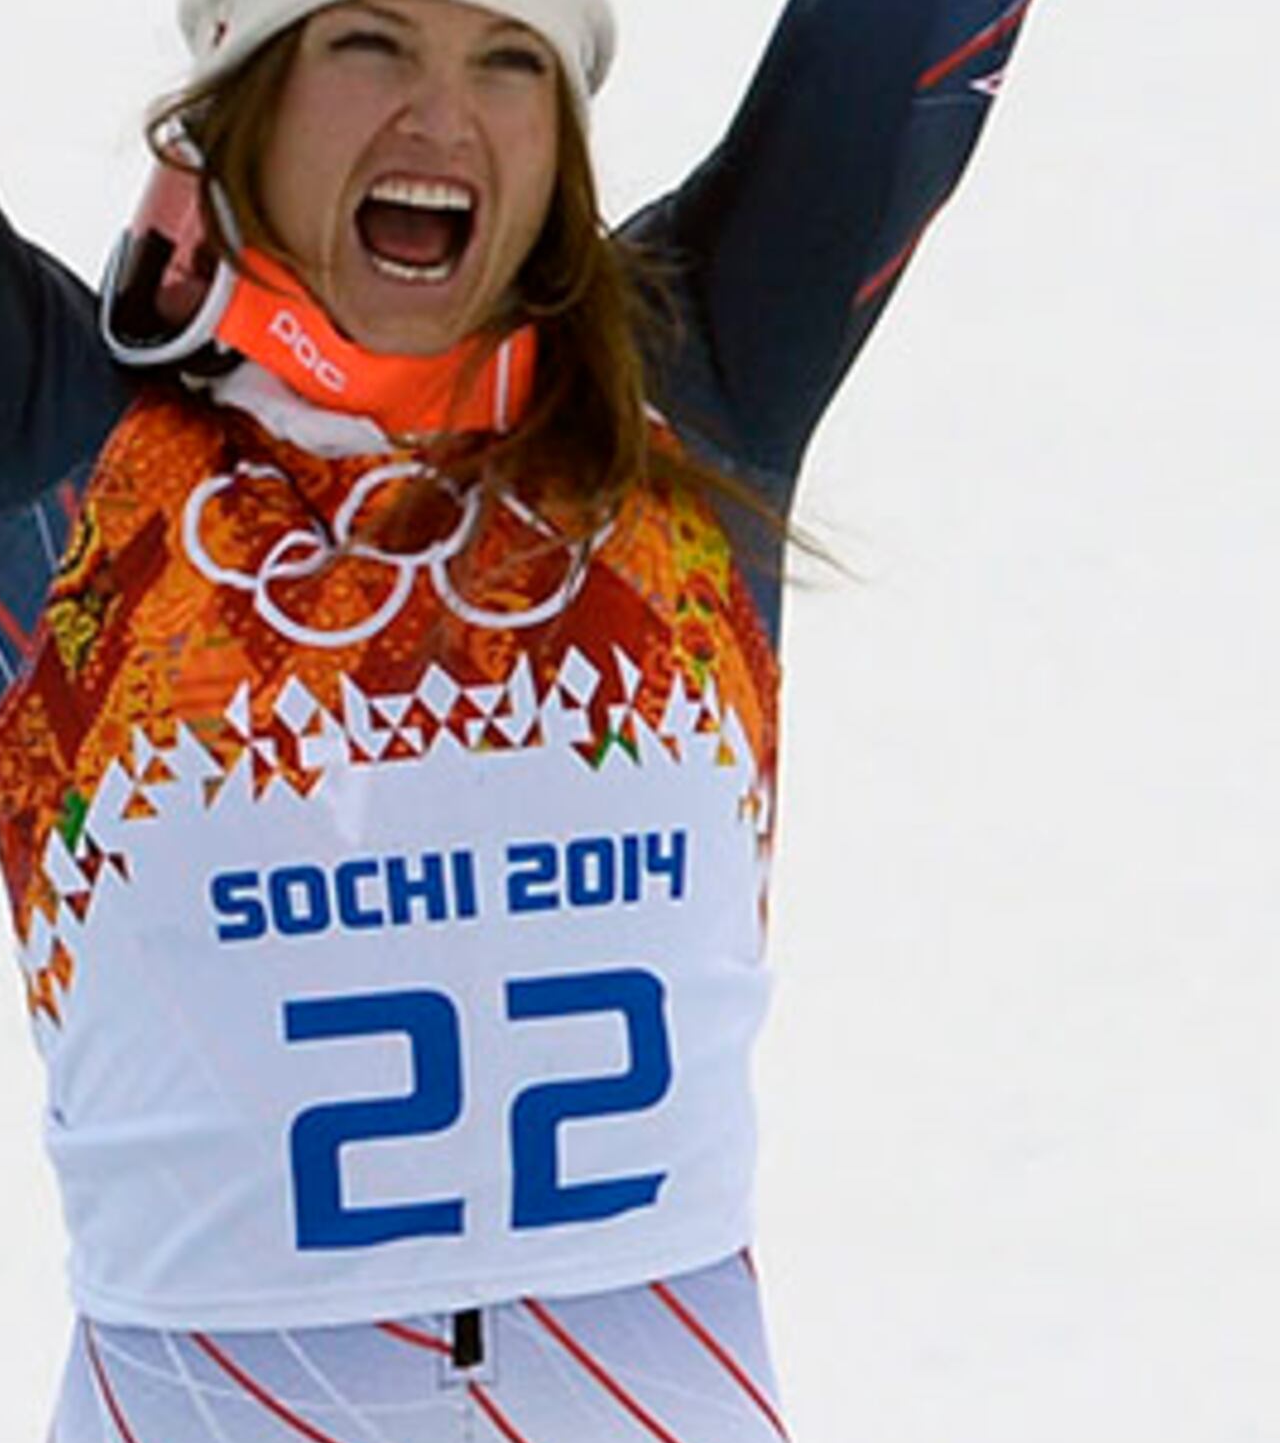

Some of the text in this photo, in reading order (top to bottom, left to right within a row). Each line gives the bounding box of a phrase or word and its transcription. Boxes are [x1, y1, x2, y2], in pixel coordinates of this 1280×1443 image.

[268, 310, 349, 393] POC
[209, 829, 688, 942] SOCHI 2014
[282, 967, 674, 1253] 22
